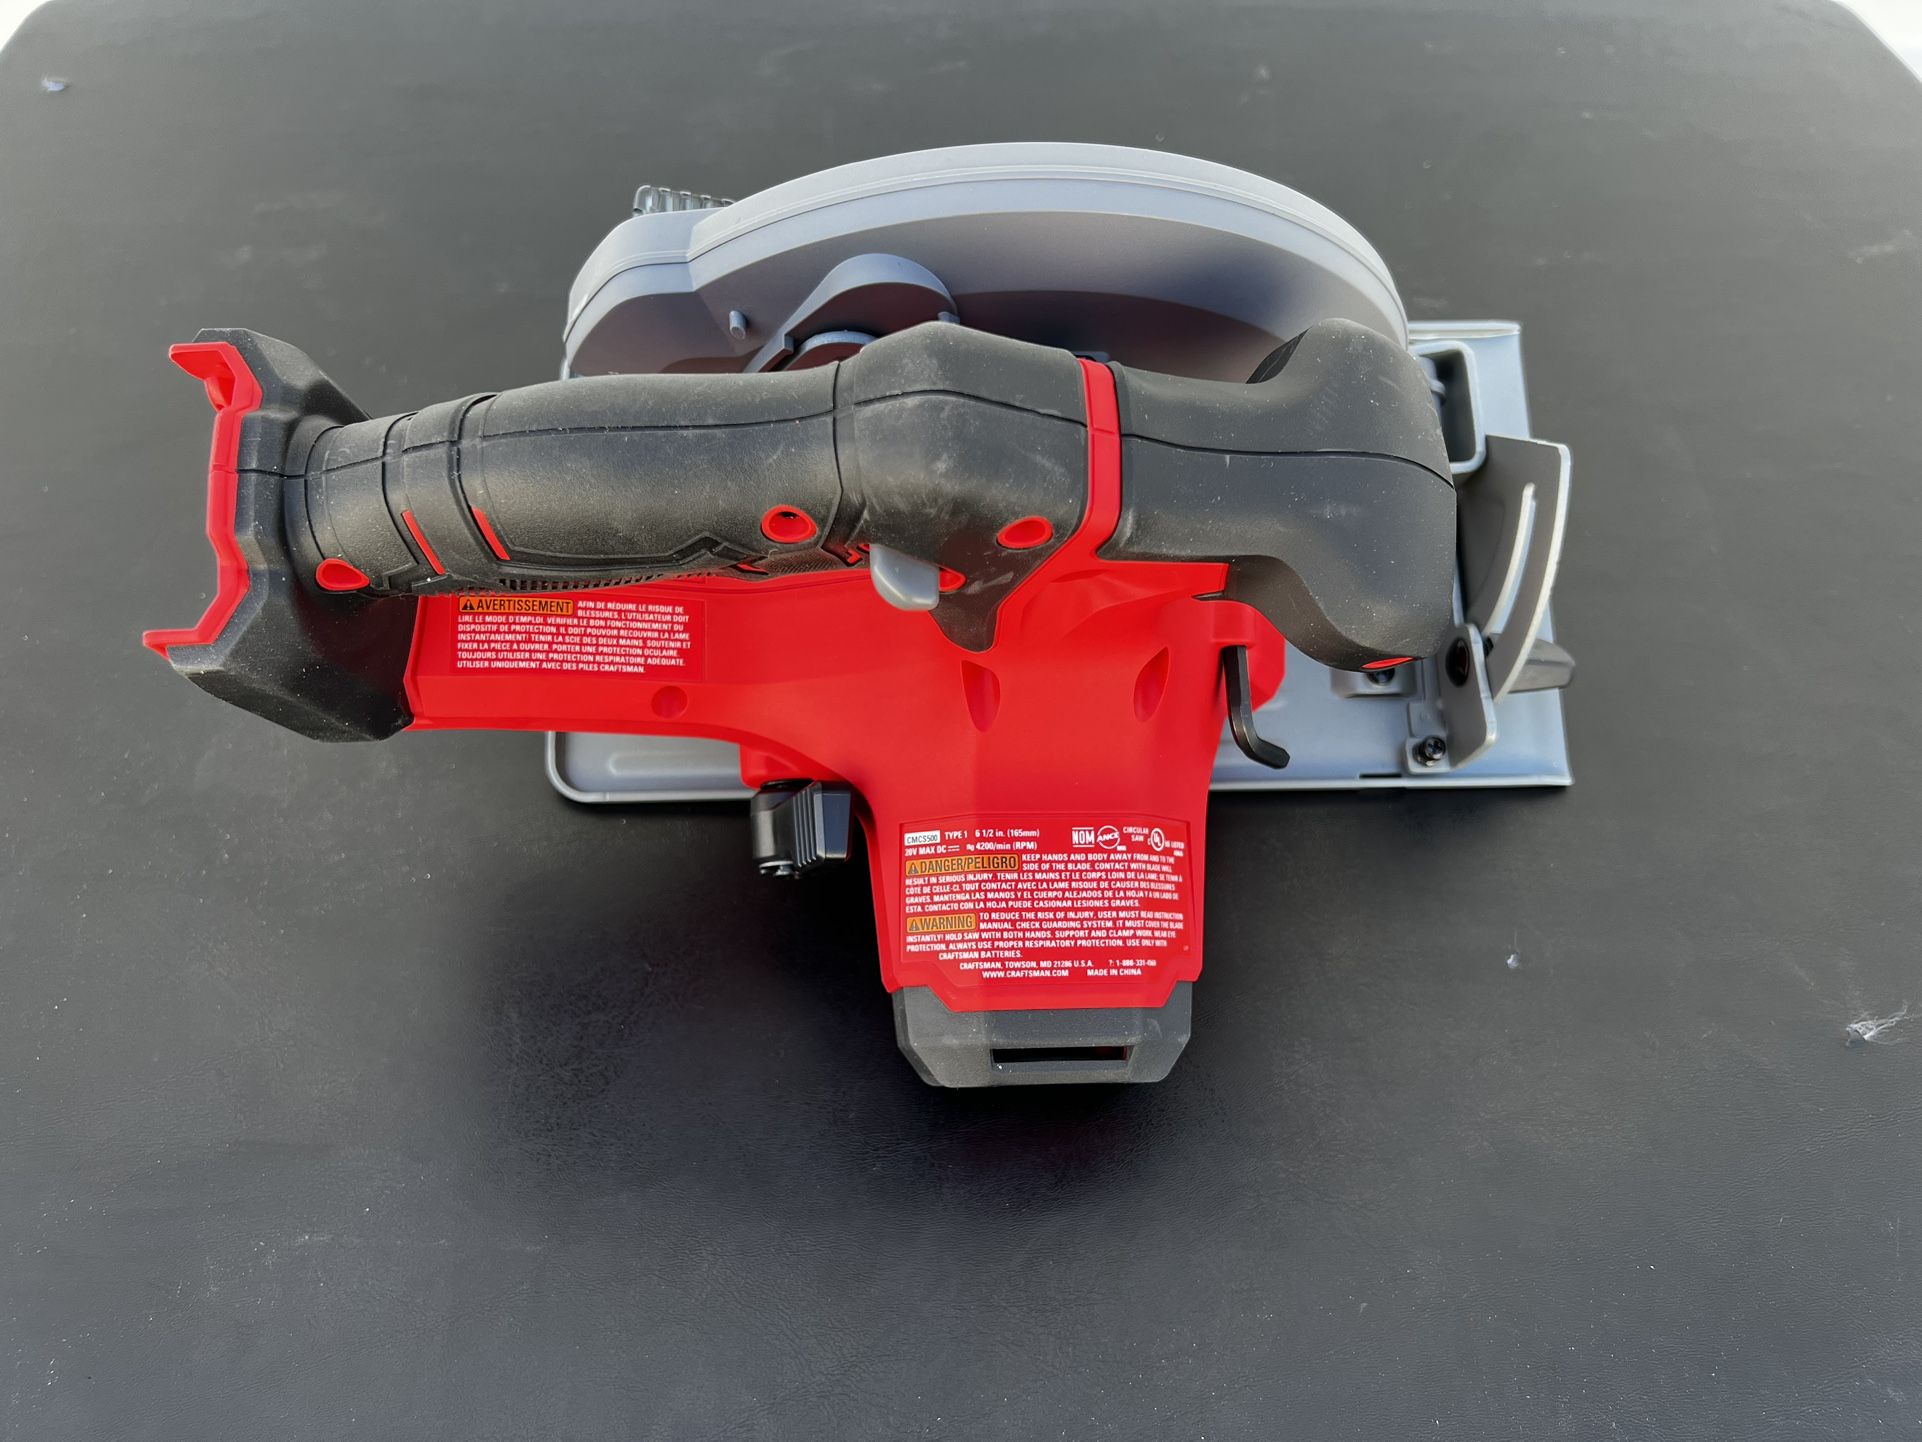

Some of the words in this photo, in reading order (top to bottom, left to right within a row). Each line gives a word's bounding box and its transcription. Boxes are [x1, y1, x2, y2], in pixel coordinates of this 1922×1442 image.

[477, 599, 571, 613] AVERTISSEMENT
[607, 620, 671, 630] FONCTIONNEMENT
[587, 628, 618, 636] POUVOIR
[620, 629, 658, 638] RECOUVRIR
[553, 644, 579, 652] PORTER
[599, 647, 642, 655] PROTECTION
[549, 653, 593, 661] PROTECTION
[596, 656, 645, 664] RESPIRATOIRE
[491, 661, 540, 669] UNIQUEMENT
[907, 834, 938, 843] CMCS500
[983, 830, 993, 838] 1/2
[1008, 829, 1039, 838] (165mm)
[1072, 831, 1094, 844] NOM
[1097, 831, 1119, 842] ANCE
[919, 846, 935, 855] MAX
[937, 845, 946, 853] DC
[1013, 842, 1037, 850] (RPM)
[920, 856, 1016, 873] DANGER/PELIGRO
[1050, 881, 1069, 889] LAME
[1072, 881, 1097, 889] RISQUE
[1111, 881, 1138, 889] CAUSER
[934, 893, 970, 902] MANTENGA
[987, 891, 1015, 899] MANOS
[1064, 890, 1102, 898] ALEJADOS
[1126, 890, 1145, 898] HOJA
[925, 902, 958, 911] CONTACTO
[960, 901, 973, 909] CON
[920, 915, 972, 930] WARNING
[964, 932, 979, 940] SAW
[1055, 930, 1089, 938] SUPPORT
[949, 942, 976, 950] ALWAYS
[939, 951, 979, 960] CRAFTSMAN
[982, 969, 1068, 978] WWW.CRAFTSMAN.COM
[1087, 968, 1108, 976] MADE
[1110, 968, 1117, 976] IN
